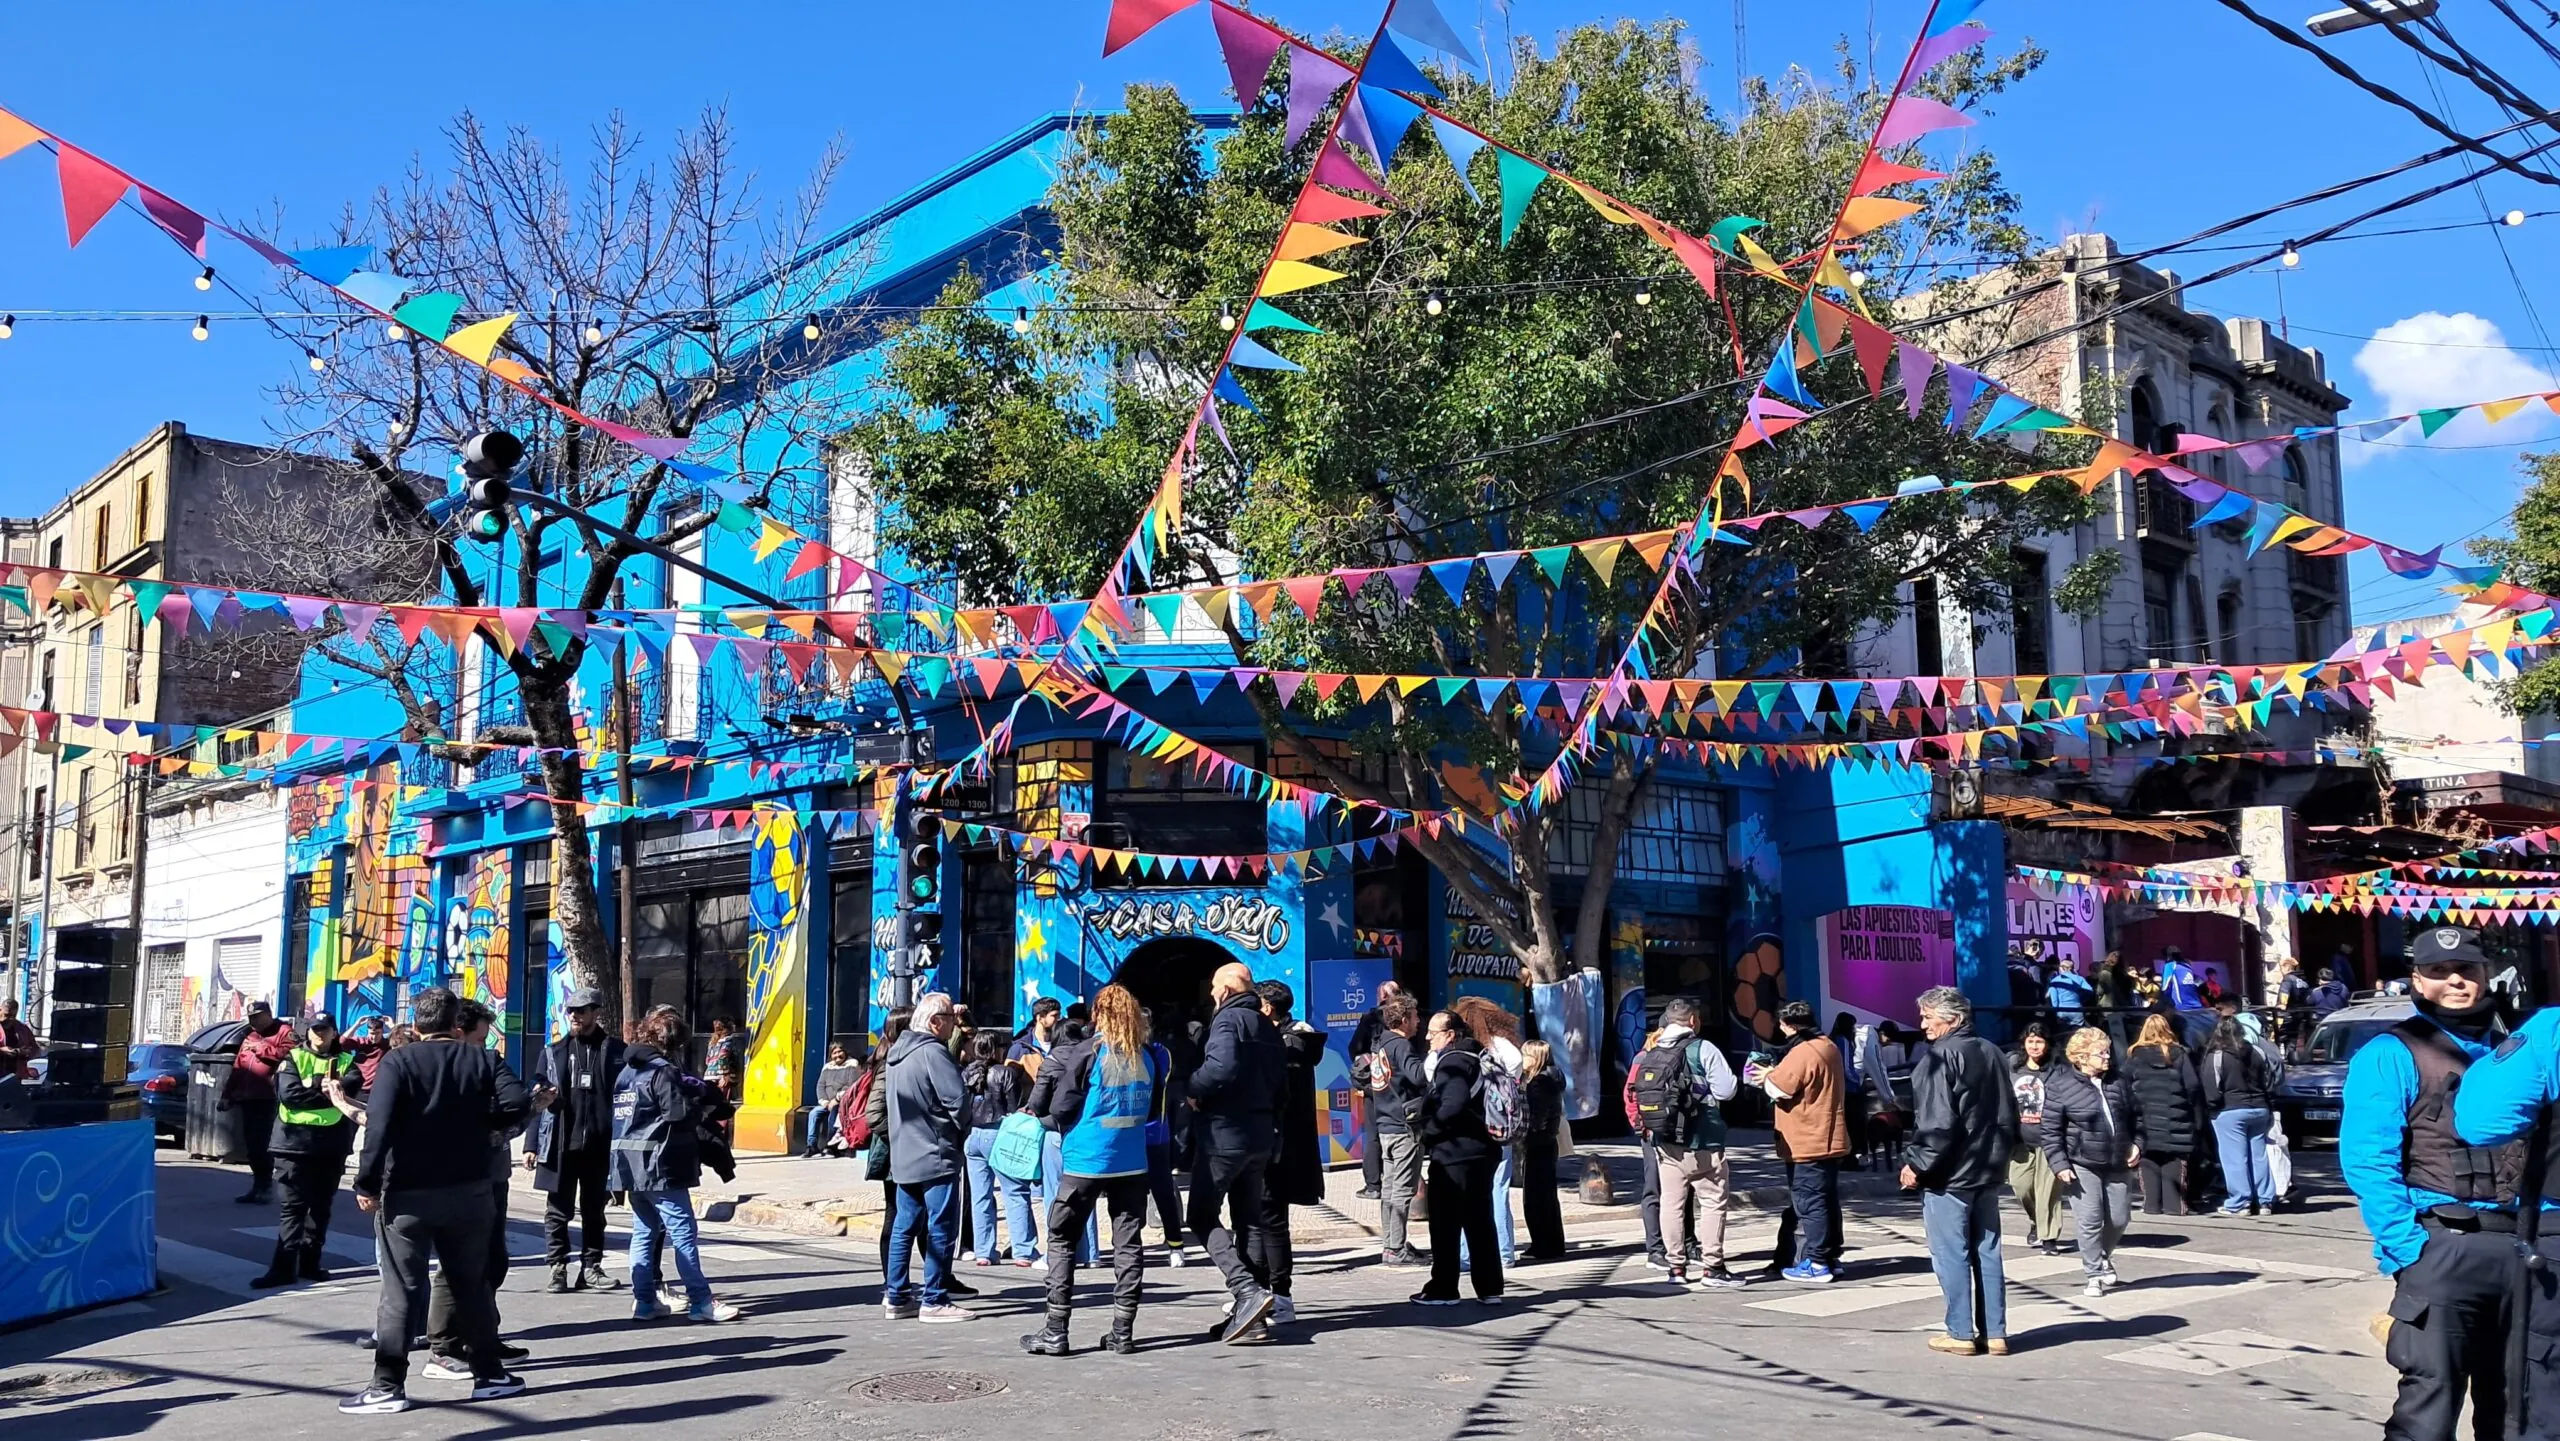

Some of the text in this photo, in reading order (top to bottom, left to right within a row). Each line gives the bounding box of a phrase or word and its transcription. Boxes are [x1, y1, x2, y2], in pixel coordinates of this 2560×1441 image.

[968, 800, 987, 809] 1300
[1110, 895, 1290, 954] CASA San
[1840, 907, 1861, 931] LAS
[1865, 906, 1920, 933] APUESTAS
[2007, 899, 2074, 935] LAR ES
[1468, 924, 1493, 946] DE
[1840, 934, 1926, 962] PARA ADULTOS.
[1341, 988, 1366, 1010] 155
